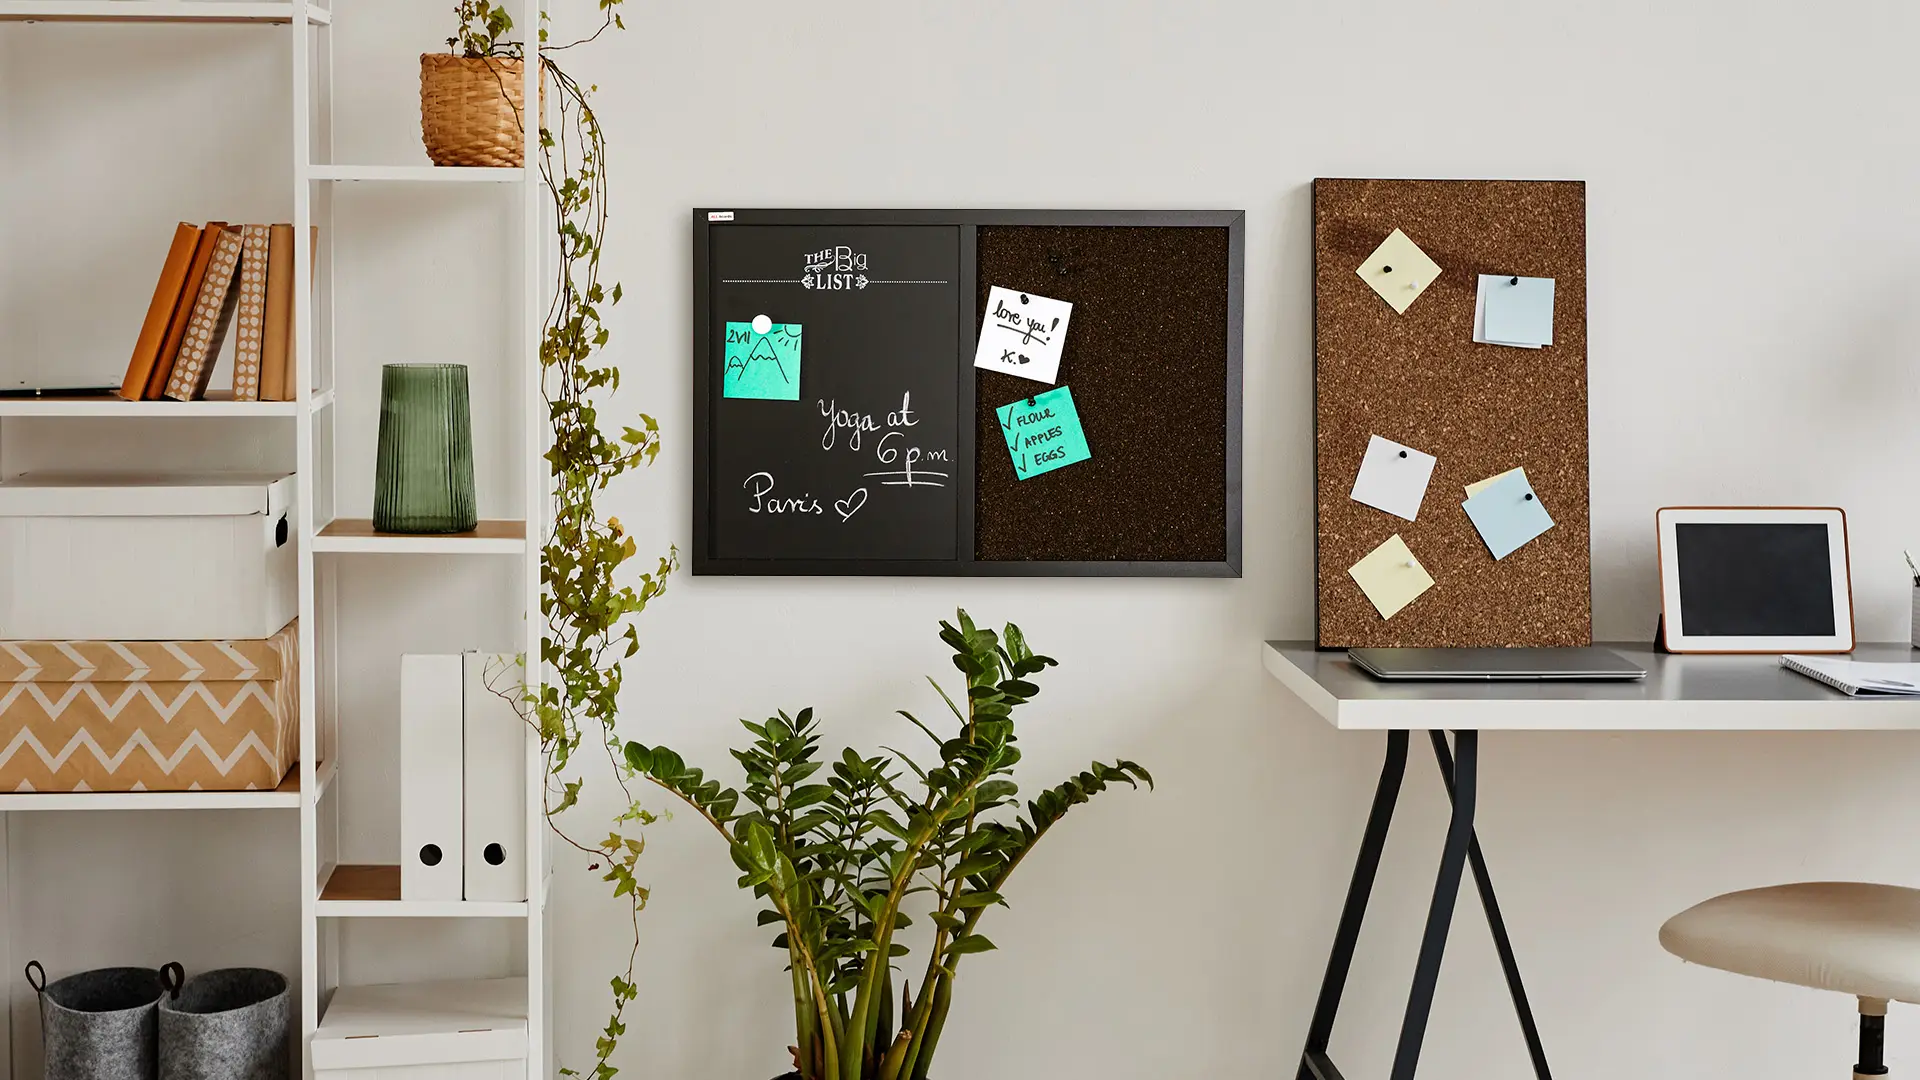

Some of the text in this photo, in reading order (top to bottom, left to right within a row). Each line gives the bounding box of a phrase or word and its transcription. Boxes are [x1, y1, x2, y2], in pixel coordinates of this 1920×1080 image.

[804, 246, 868, 271] THE Big
[816, 273, 853, 290] LIST
[887, 390, 919, 427] at
[1016, 408, 1056, 427] FLOUR
[877, 432, 905, 463] 6
[1024, 425, 1063, 449] APPLES
[1034, 446, 1066, 466] EGGS
[744, 472, 823, 515] Paris
